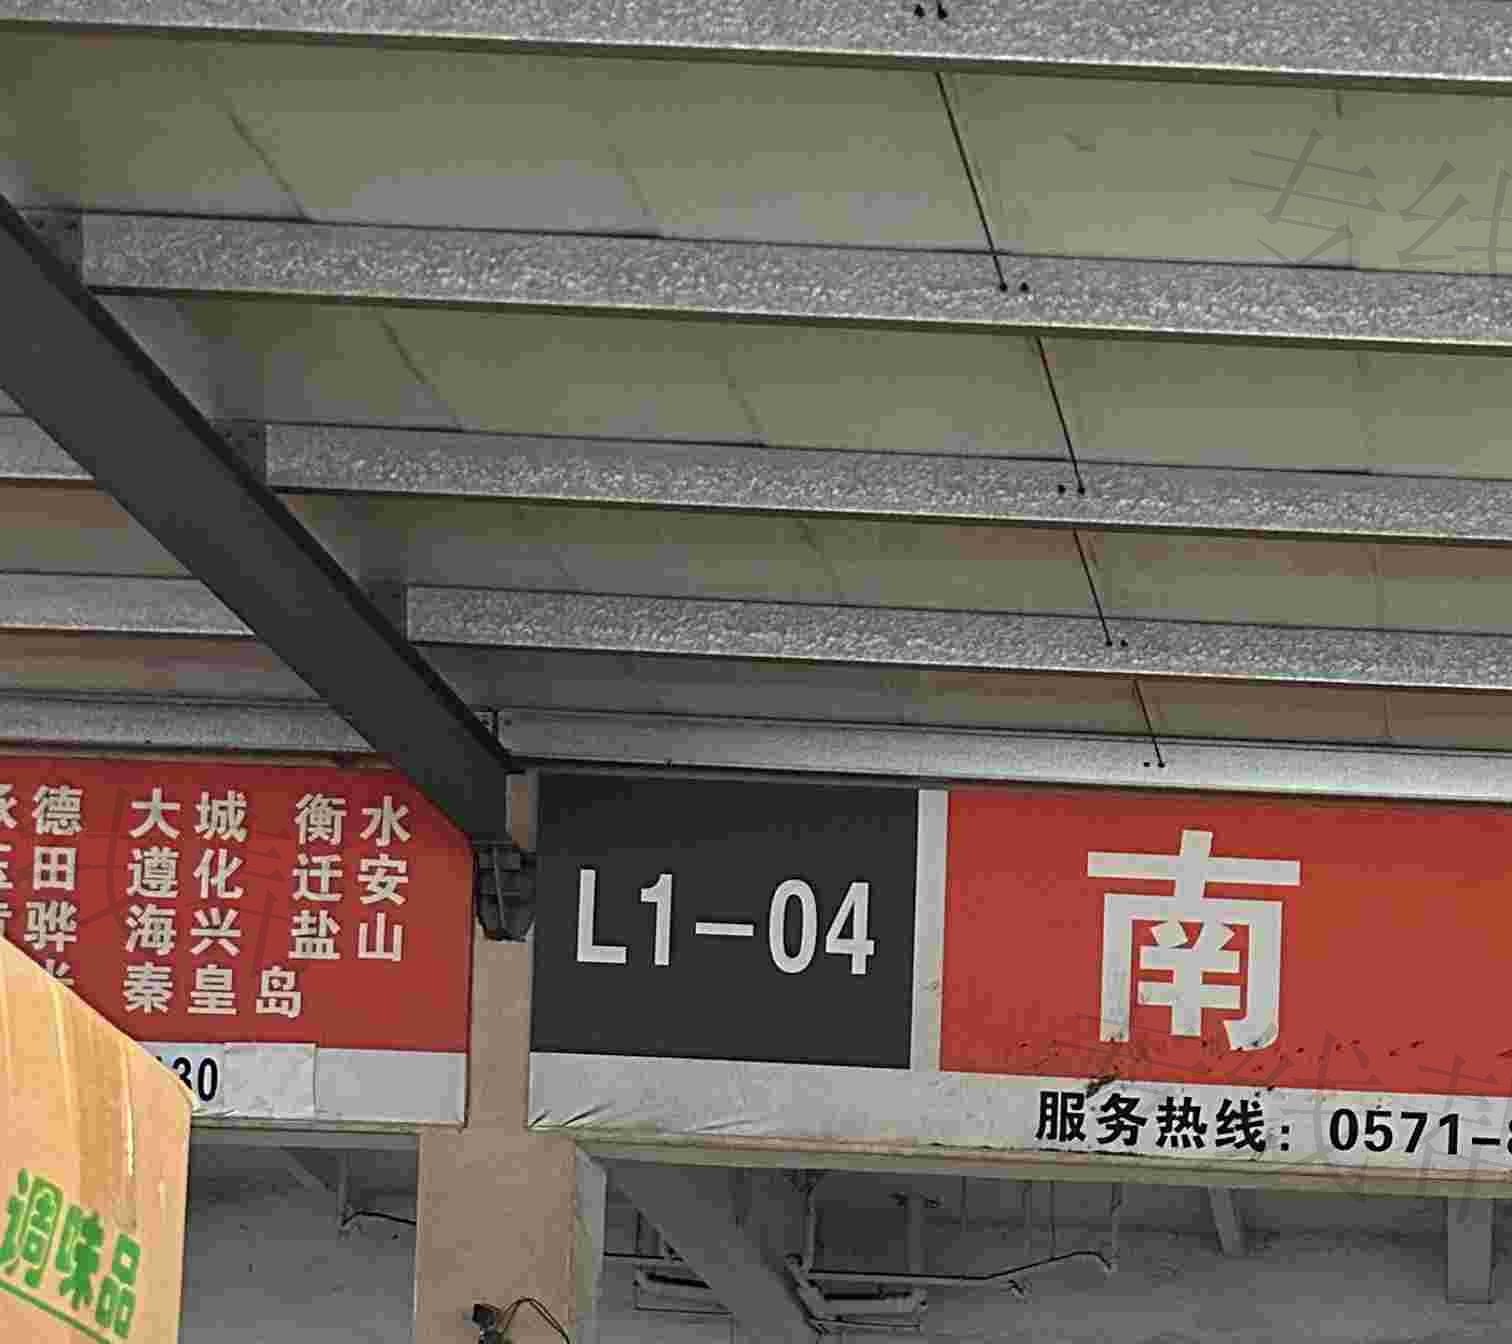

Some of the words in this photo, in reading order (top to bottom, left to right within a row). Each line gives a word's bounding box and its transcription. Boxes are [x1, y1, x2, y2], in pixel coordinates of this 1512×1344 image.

[130, 788, 248, 844] 大城
[295, 793, 412, 847] 衡水
[0, 842, 77, 891] 田
[126, 845, 245, 901] 遵化
[291, 851, 410, 906] 迁安
[0, 899, 78, 953] 骅
[125, 905, 243, 959] 海兴
[289, 911, 405, 963] 盐山
[123, 964, 303, 1018] 秦皇岛
